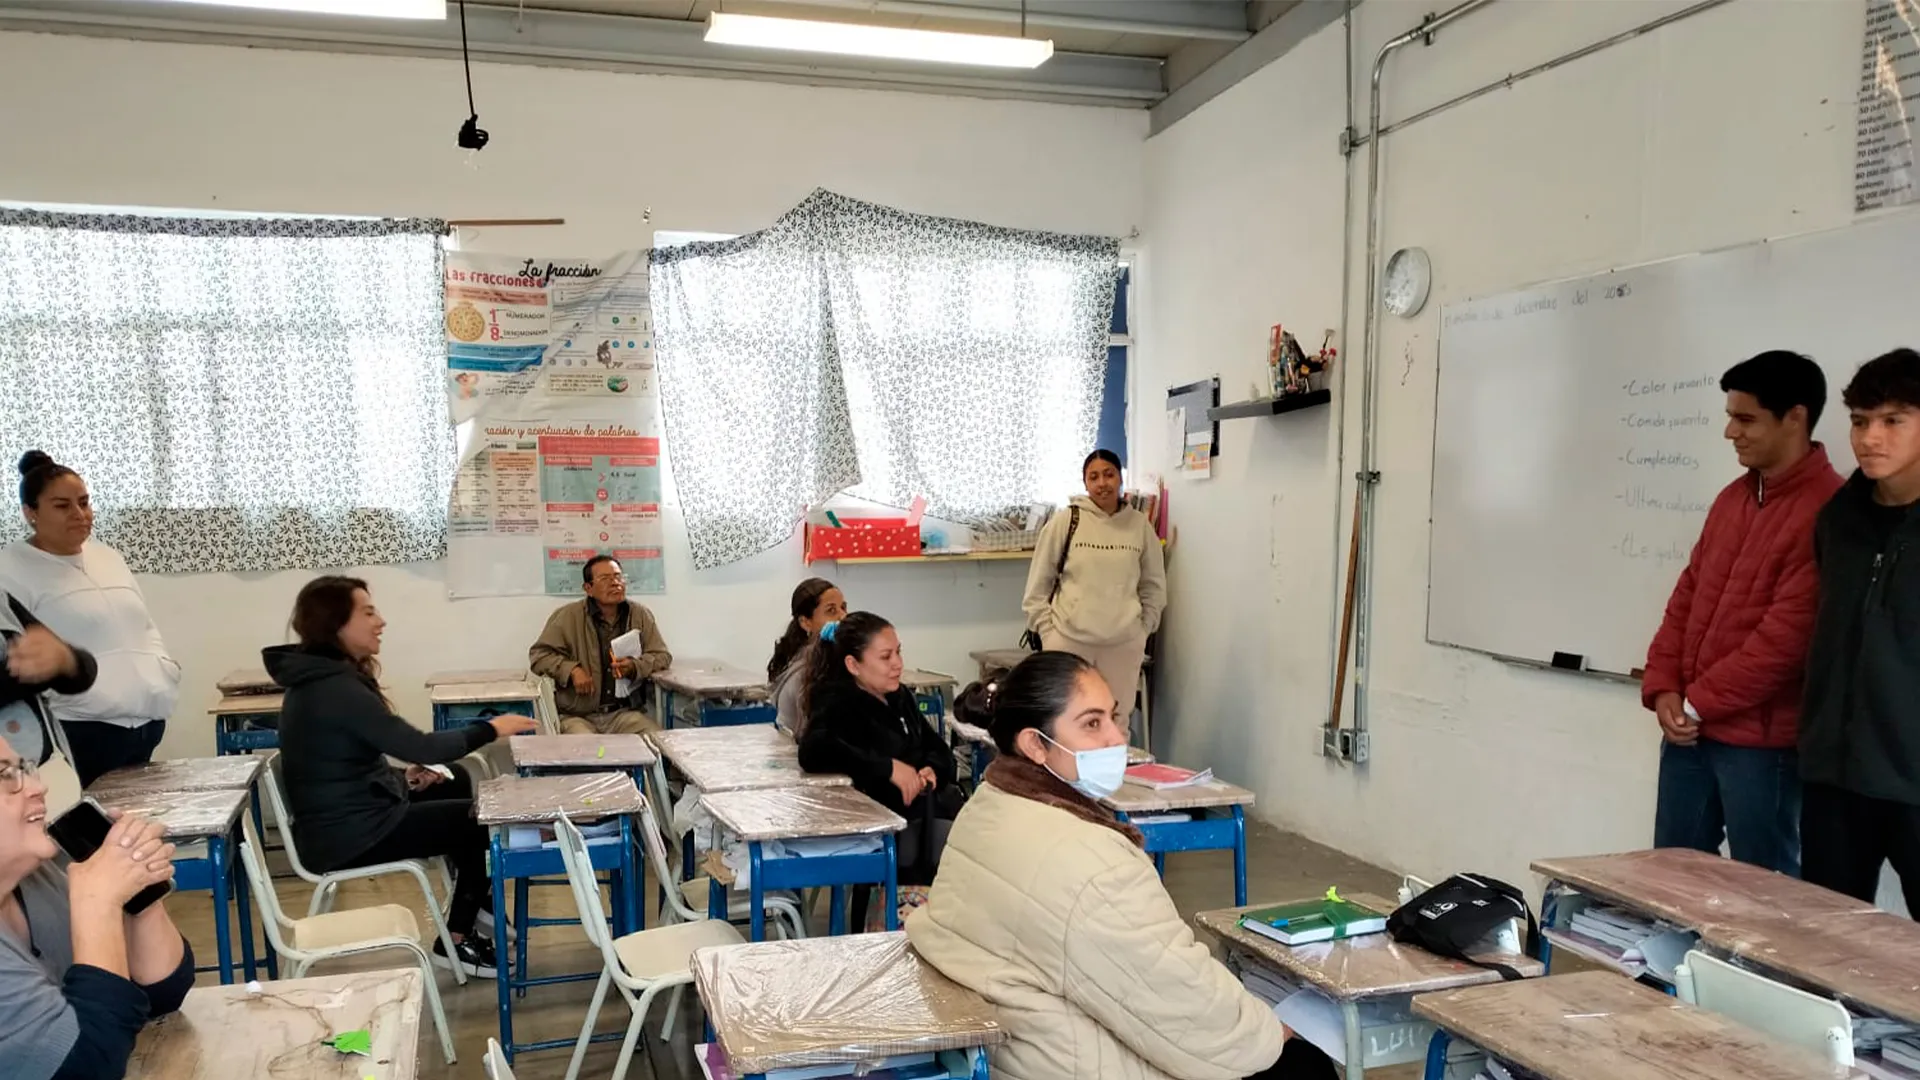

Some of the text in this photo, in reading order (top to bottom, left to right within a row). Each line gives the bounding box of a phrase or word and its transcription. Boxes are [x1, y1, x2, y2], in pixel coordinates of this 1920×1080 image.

[446, 268, 466, 282] Las
[518, 258, 543, 280] La
[489, 308, 497, 322] 1
[490, 326, 500, 341] 8
[584, 423, 596, 436] de
[598, 424, 640, 437] palabras
